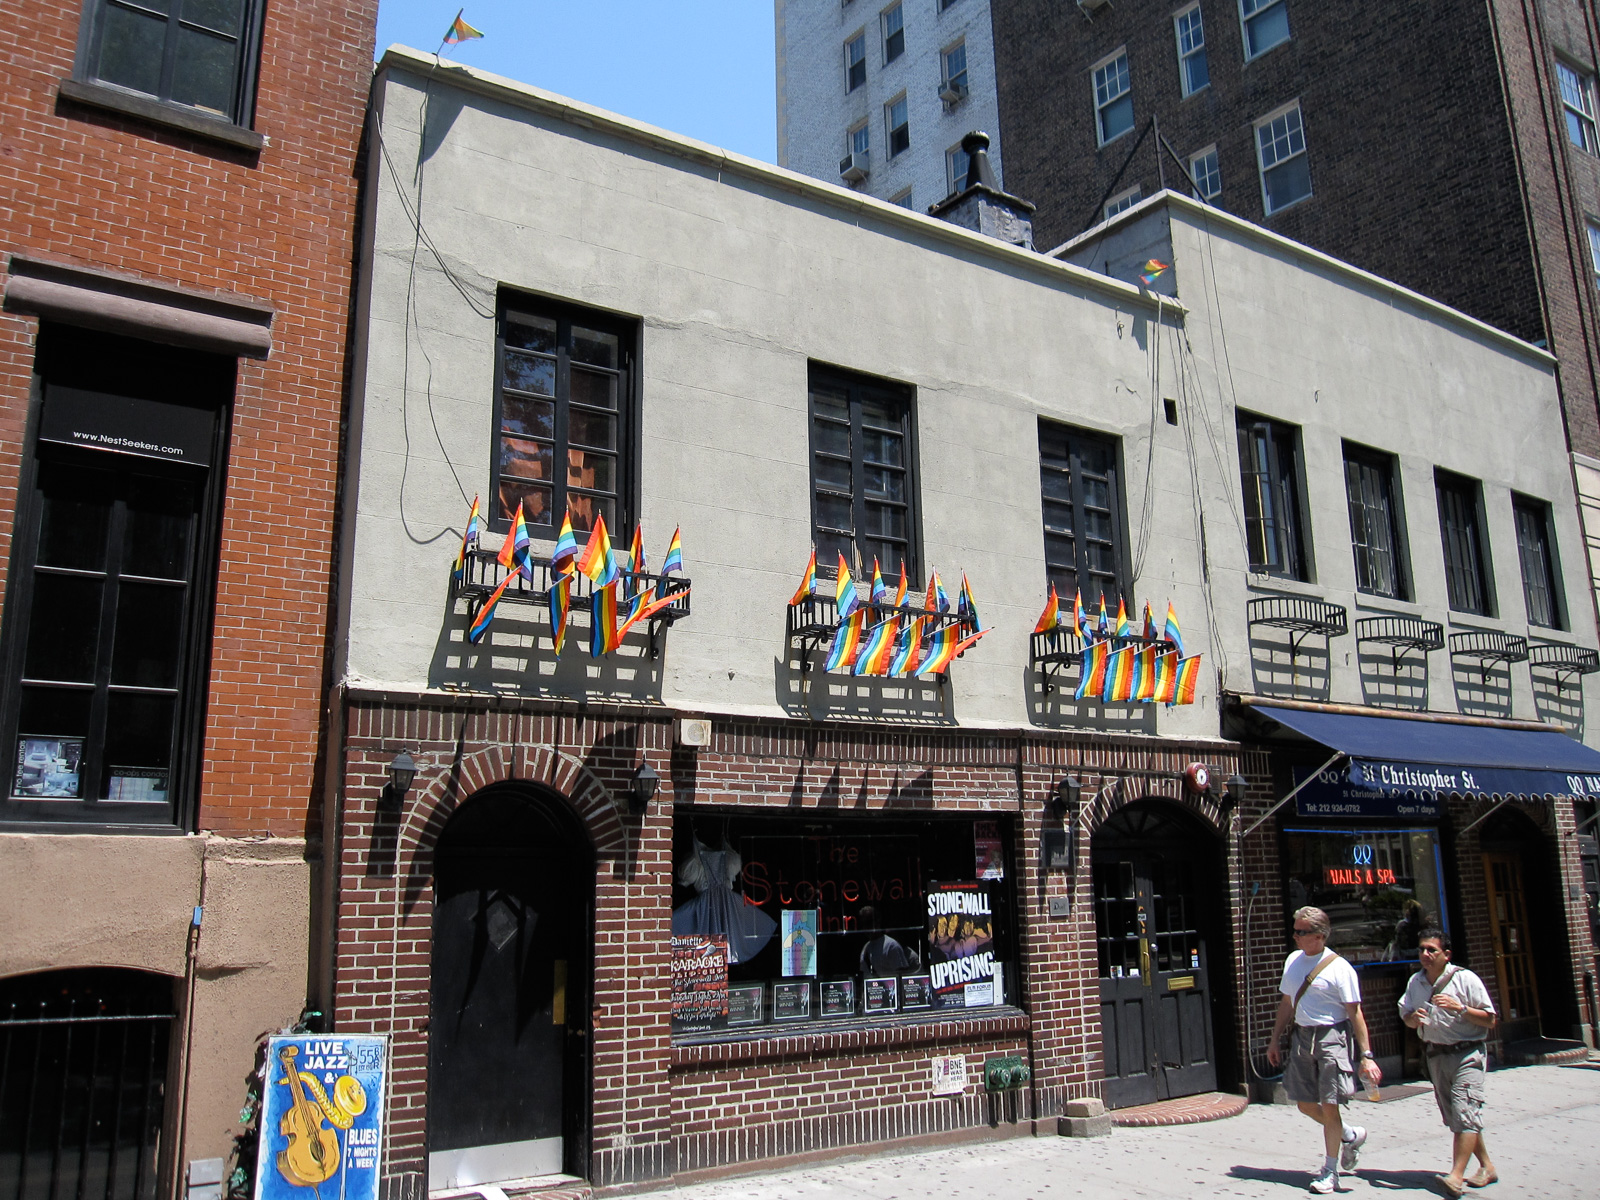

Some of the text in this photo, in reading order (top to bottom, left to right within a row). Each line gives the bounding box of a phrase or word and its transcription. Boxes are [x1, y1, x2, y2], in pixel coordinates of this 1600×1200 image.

[73, 431, 184, 455] www.NestSeekers.com
[18, 740, 26, 763] rentals
[114, 770, 168, 779] co-ops condos
[1318, 770, 1339, 784] QQ
[1381, 765, 1455, 791] Christopher
[1461, 771, 1480, 789] St.
[1566, 775, 1600, 795] QQ NA
[1351, 790, 1385, 799] Christopher
[1319, 803, 1330, 813] 212
[1331, 804, 1361, 813] 924-0782
[1398, 804, 1436, 815] Open 7 days
[808, 836, 859, 863] The
[742, 857, 923, 907] Stonewall
[1329, 869, 1361, 885] NAILS
[1377, 868, 1396, 884] SPA
[927, 891, 992, 917] STONEWALL
[817, 907, 858, 932] Inn
[670, 936, 704, 947] Danielle
[670, 954, 724, 972] KARAOKE
[930, 951, 994, 990] UPRISING
[305, 1042, 343, 1055] LIVE
[304, 1056, 348, 1070] JAZZ
[360, 1049, 374, 1064] 55
[950, 1060, 962, 1070] BNE
[324, 1072, 335, 1083] &
[349, 1128, 378, 1145] BLUES
[347, 1147, 377, 1158] 7 NIGHTS
[348, 1158, 375, 1169] A WEEK
